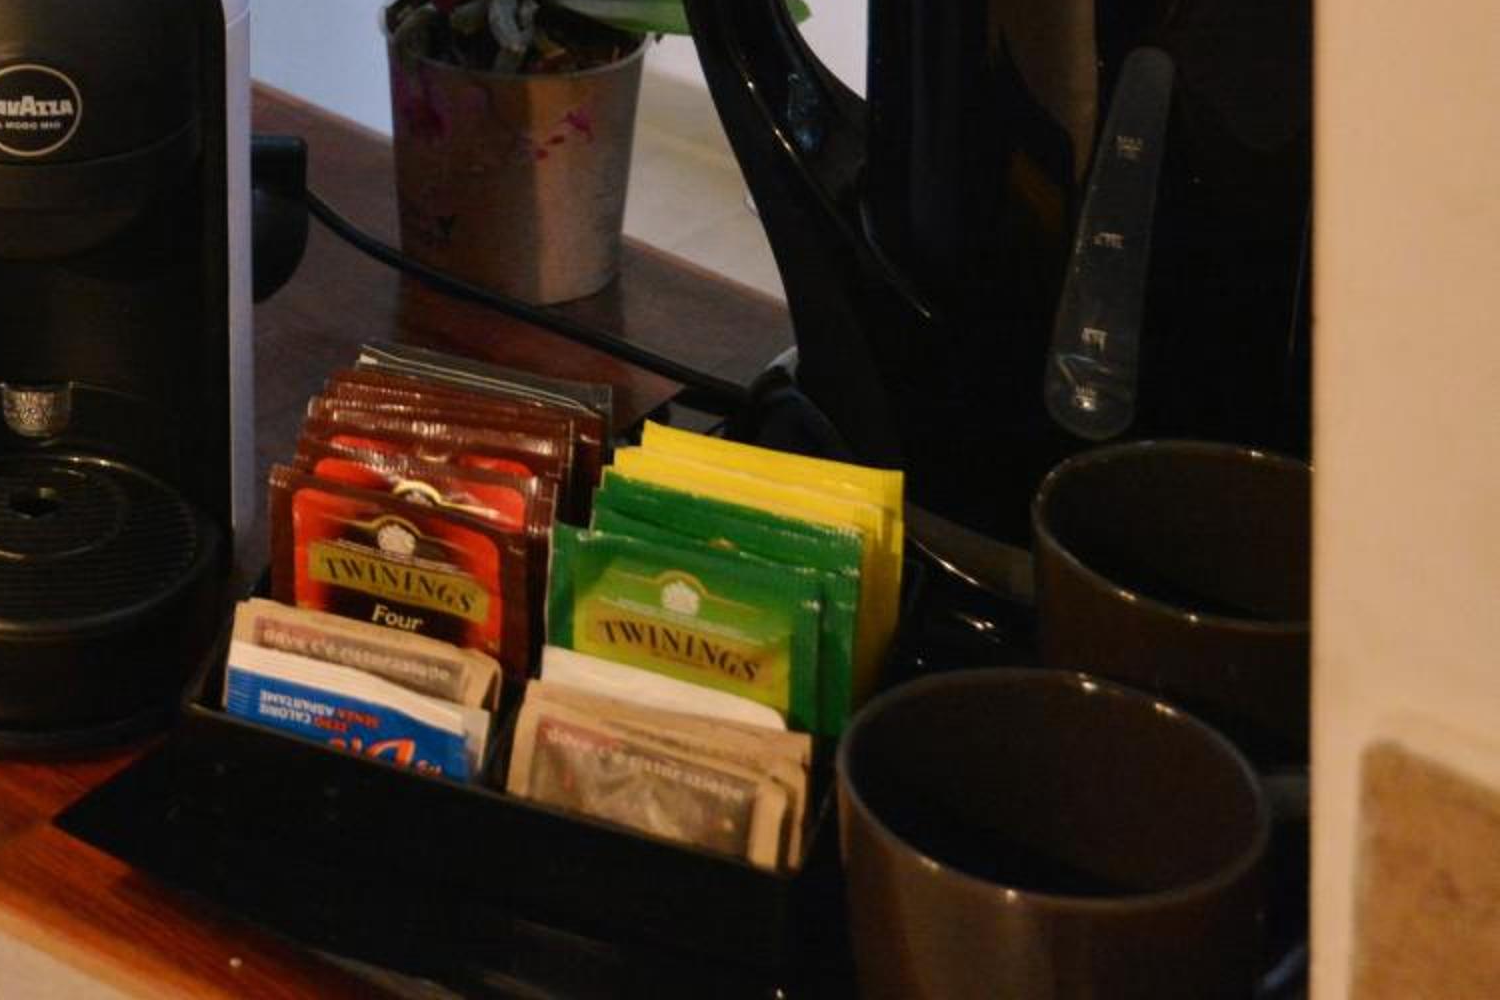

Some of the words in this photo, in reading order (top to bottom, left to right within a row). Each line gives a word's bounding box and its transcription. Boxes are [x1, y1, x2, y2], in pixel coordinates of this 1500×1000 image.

[321, 556, 476, 614] TWININGS
[371, 604, 425, 631] Four
[598, 619, 760, 682] TWININGS
